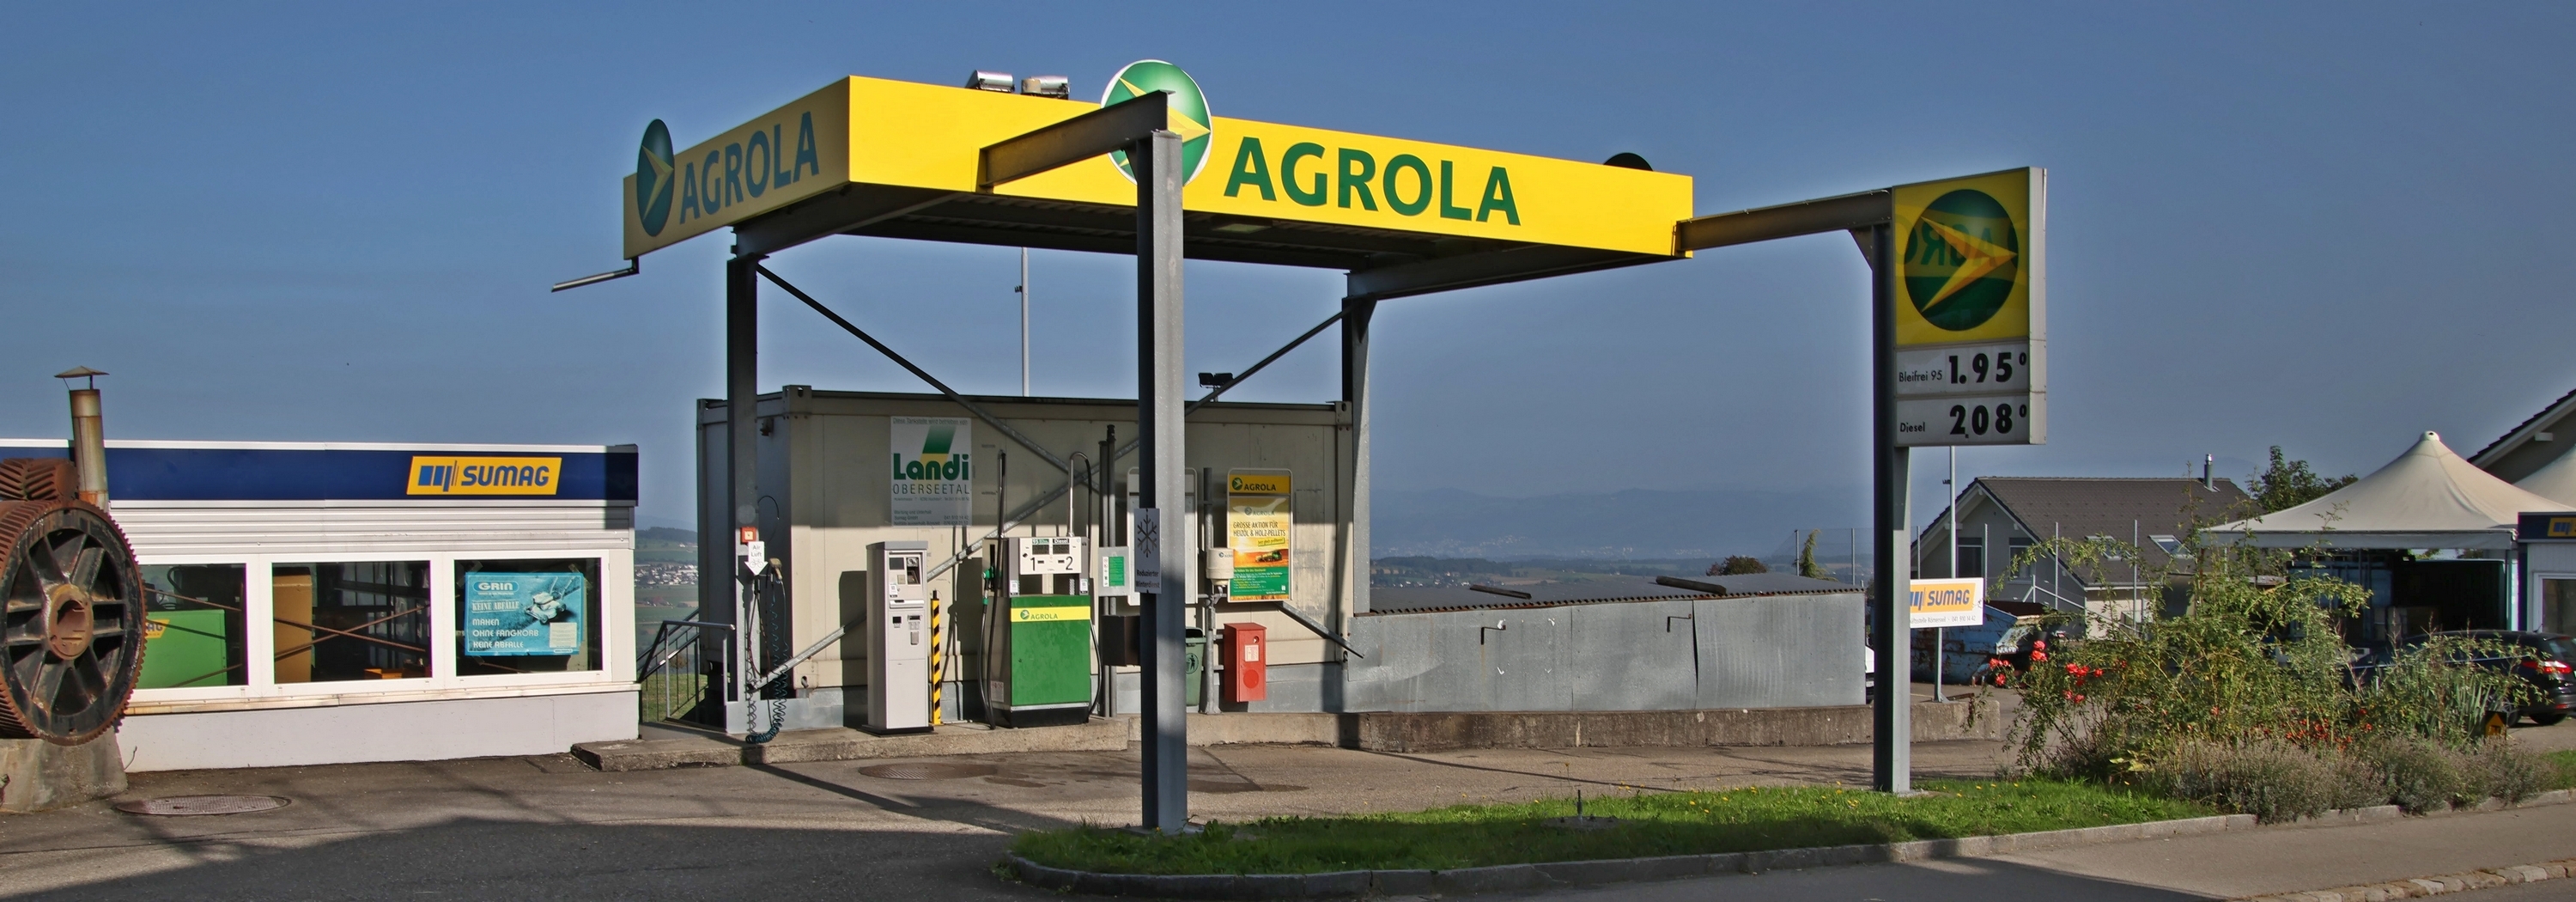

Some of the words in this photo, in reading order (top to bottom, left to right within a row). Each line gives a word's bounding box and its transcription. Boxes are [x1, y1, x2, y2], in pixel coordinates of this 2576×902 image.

[679, 111, 820, 225] AGROLA
[1224, 136, 1522, 226] AGROLA
[1899, 370, 1929, 382] Bleifrei
[1930, 369, 1942, 381] 95
[1899, 422, 1926, 433] Diesel
[893, 453, 969, 481] Landi
[461, 465, 550, 487] SUMAG
[893, 484, 970, 495] OBERSEETAL
[1243, 483, 1277, 491] AGROLA
[1233, 521, 1251, 529] GROSSE
[1269, 520, 1279, 528] FÜR
[1030, 557, 1036, 571] 1
[1066, 556, 1073, 570] 2
[477, 582, 513, 591] GRIN
[1927, 589, 1971, 606] SUMAG
[472, 602, 492, 611] KEINE
